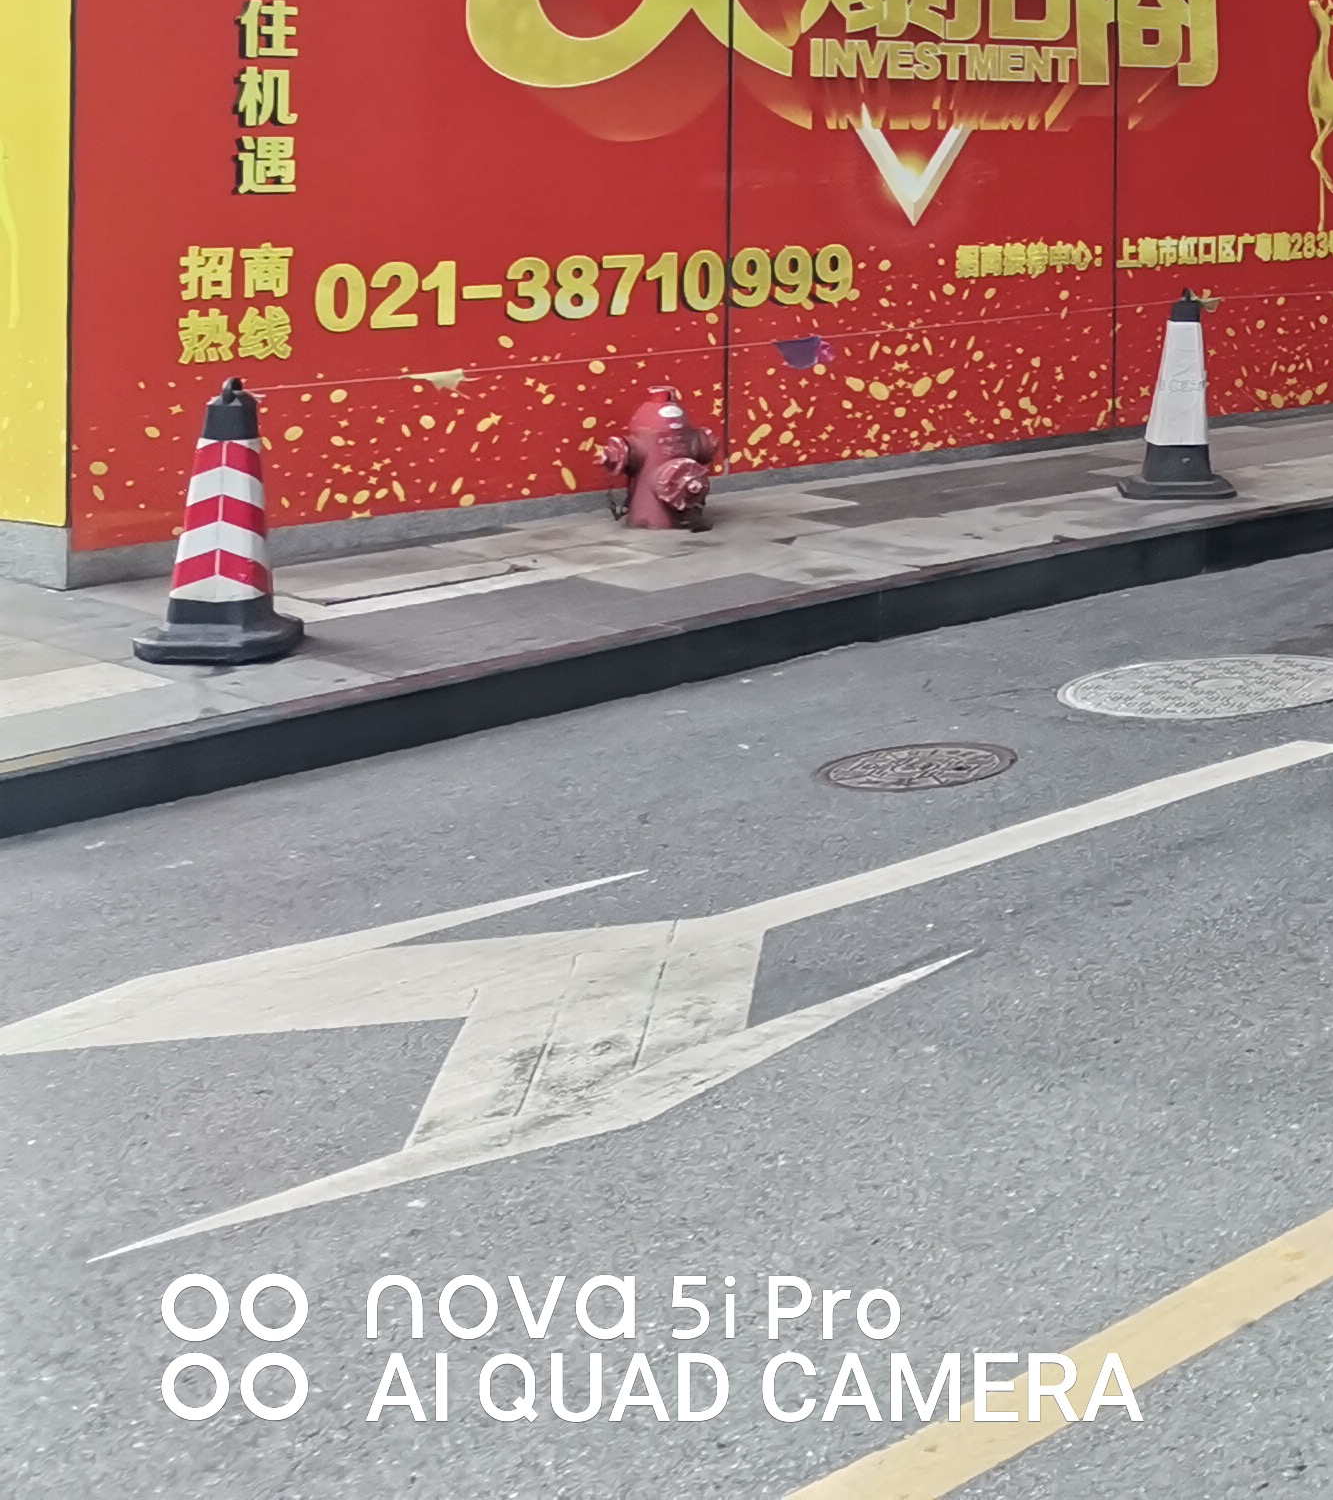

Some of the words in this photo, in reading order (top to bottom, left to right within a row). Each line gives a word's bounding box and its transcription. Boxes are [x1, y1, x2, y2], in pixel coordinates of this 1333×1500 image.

[809, 37, 1078, 83] INVESTMENT
[178, 242, 294, 301] 招商
[314, 243, 853, 332] 021-38710999
[178, 306, 293, 365] 热线
